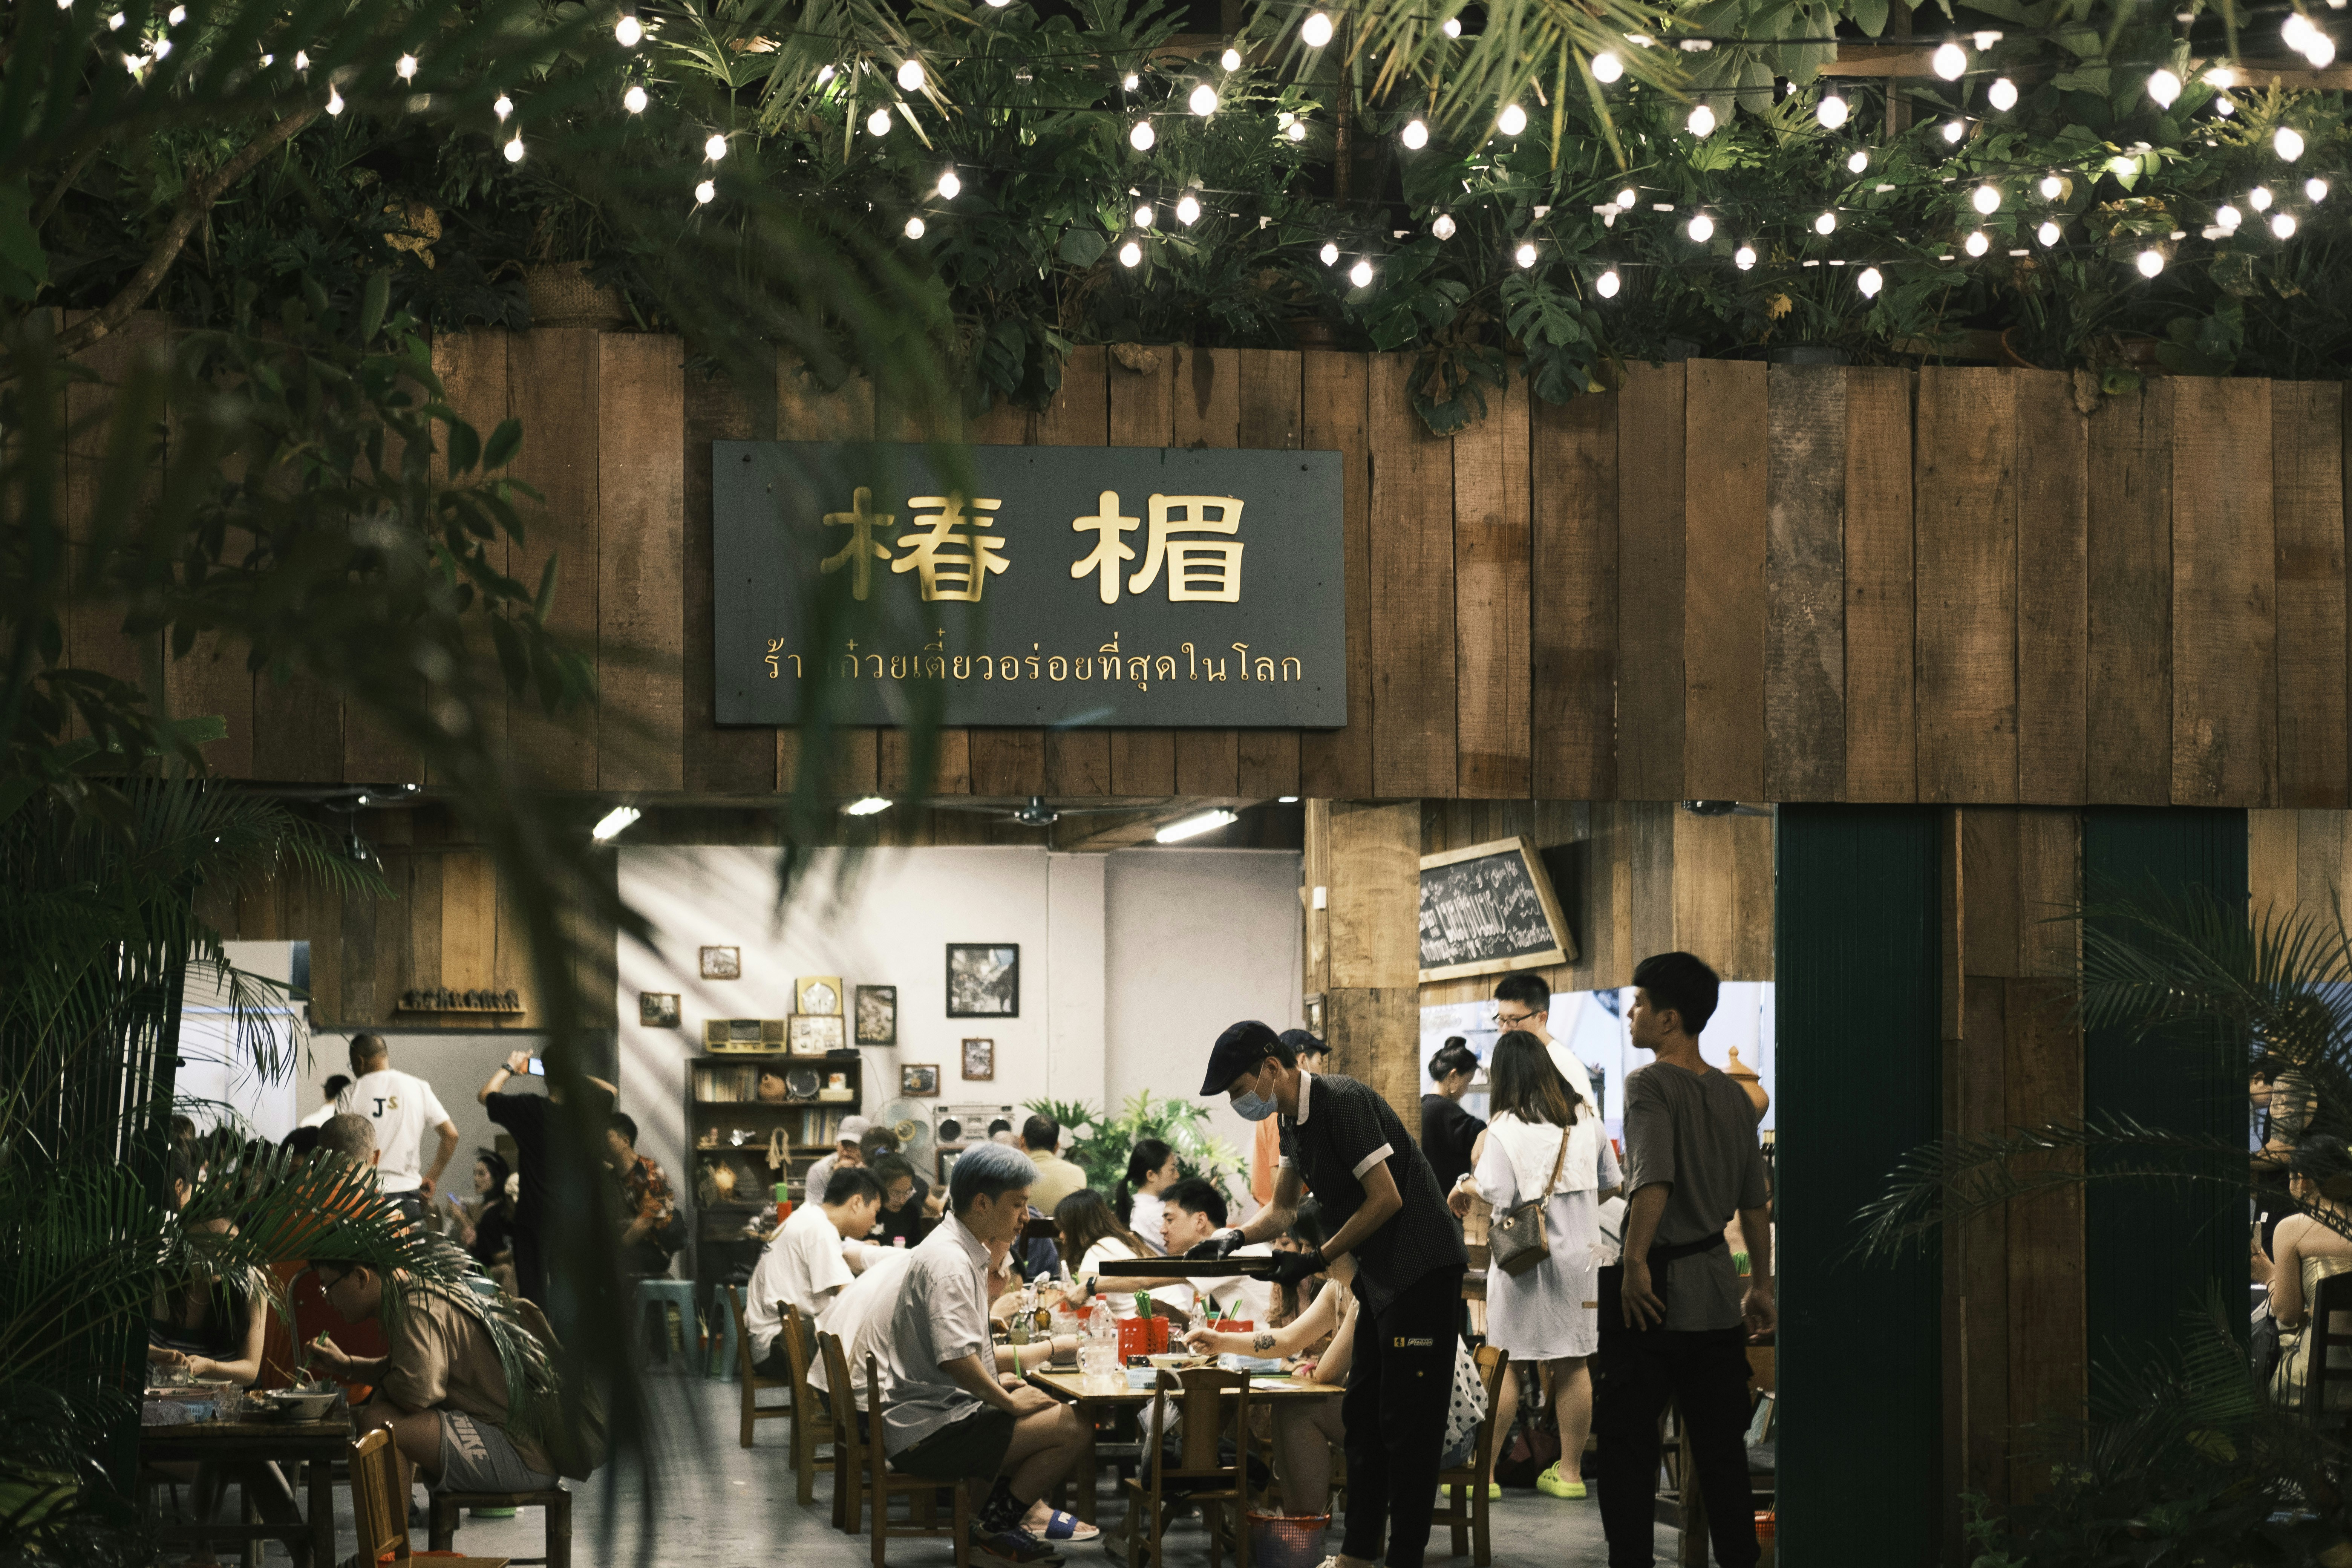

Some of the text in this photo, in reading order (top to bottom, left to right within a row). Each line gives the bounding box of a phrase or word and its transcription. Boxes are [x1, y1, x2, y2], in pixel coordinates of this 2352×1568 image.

[764, 628, 1302, 692] ร้าก๋วยเตี๋ยวอร่อยที่สุดในโลก
[451, 1413, 490, 1461] NIKE
